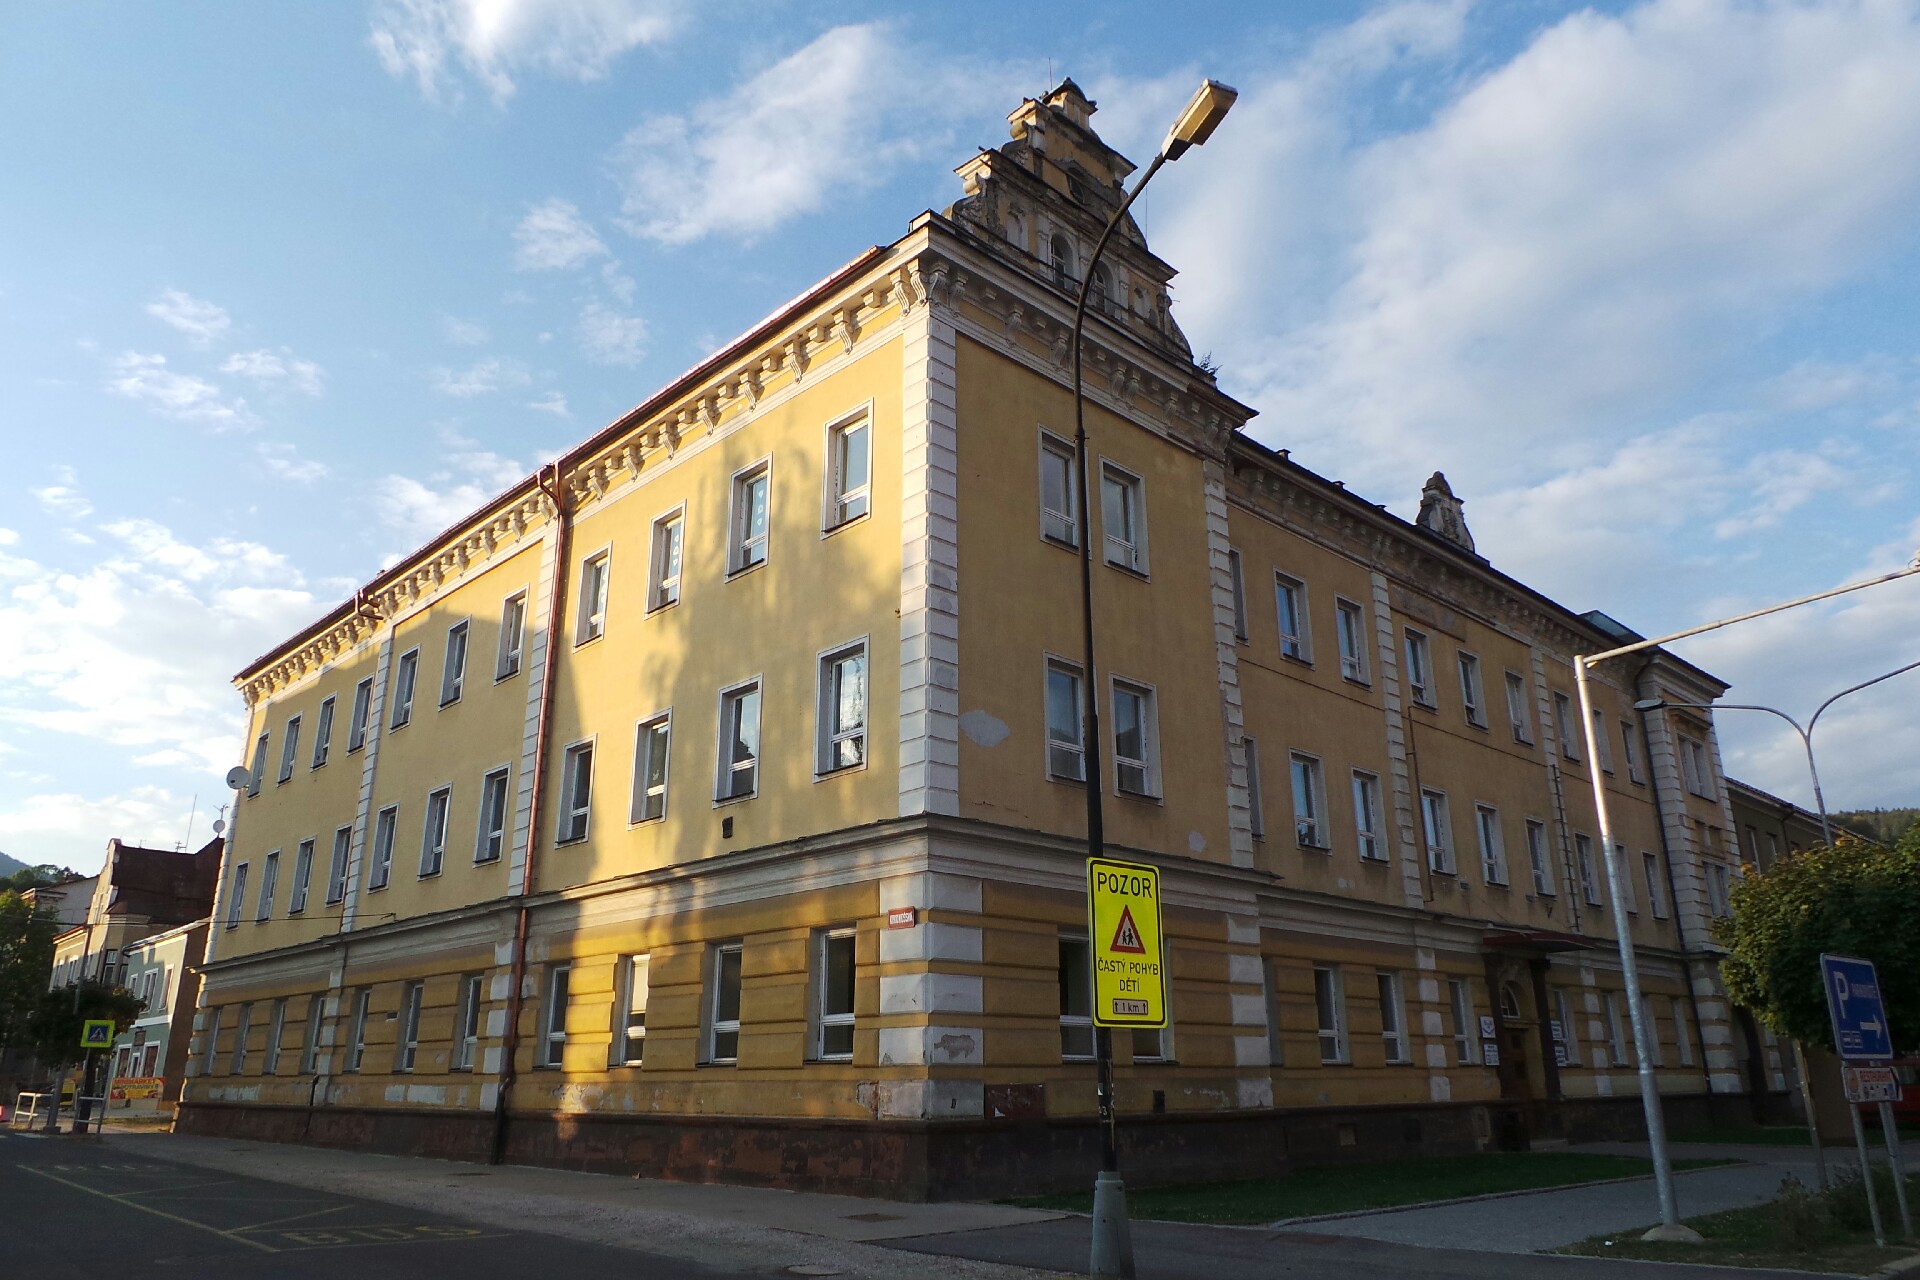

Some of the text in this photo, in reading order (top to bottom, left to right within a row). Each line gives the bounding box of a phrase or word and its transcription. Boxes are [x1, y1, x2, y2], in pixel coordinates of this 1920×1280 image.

[1097, 871, 1152, 898] POZOR
[1098, 957, 1158, 975] ČASTÝ POHYB
[1120, 977, 1139, 992] DĚTÍ
[1128, 1003, 1139, 1012] km
[280, 1225, 481, 1245] BUS
